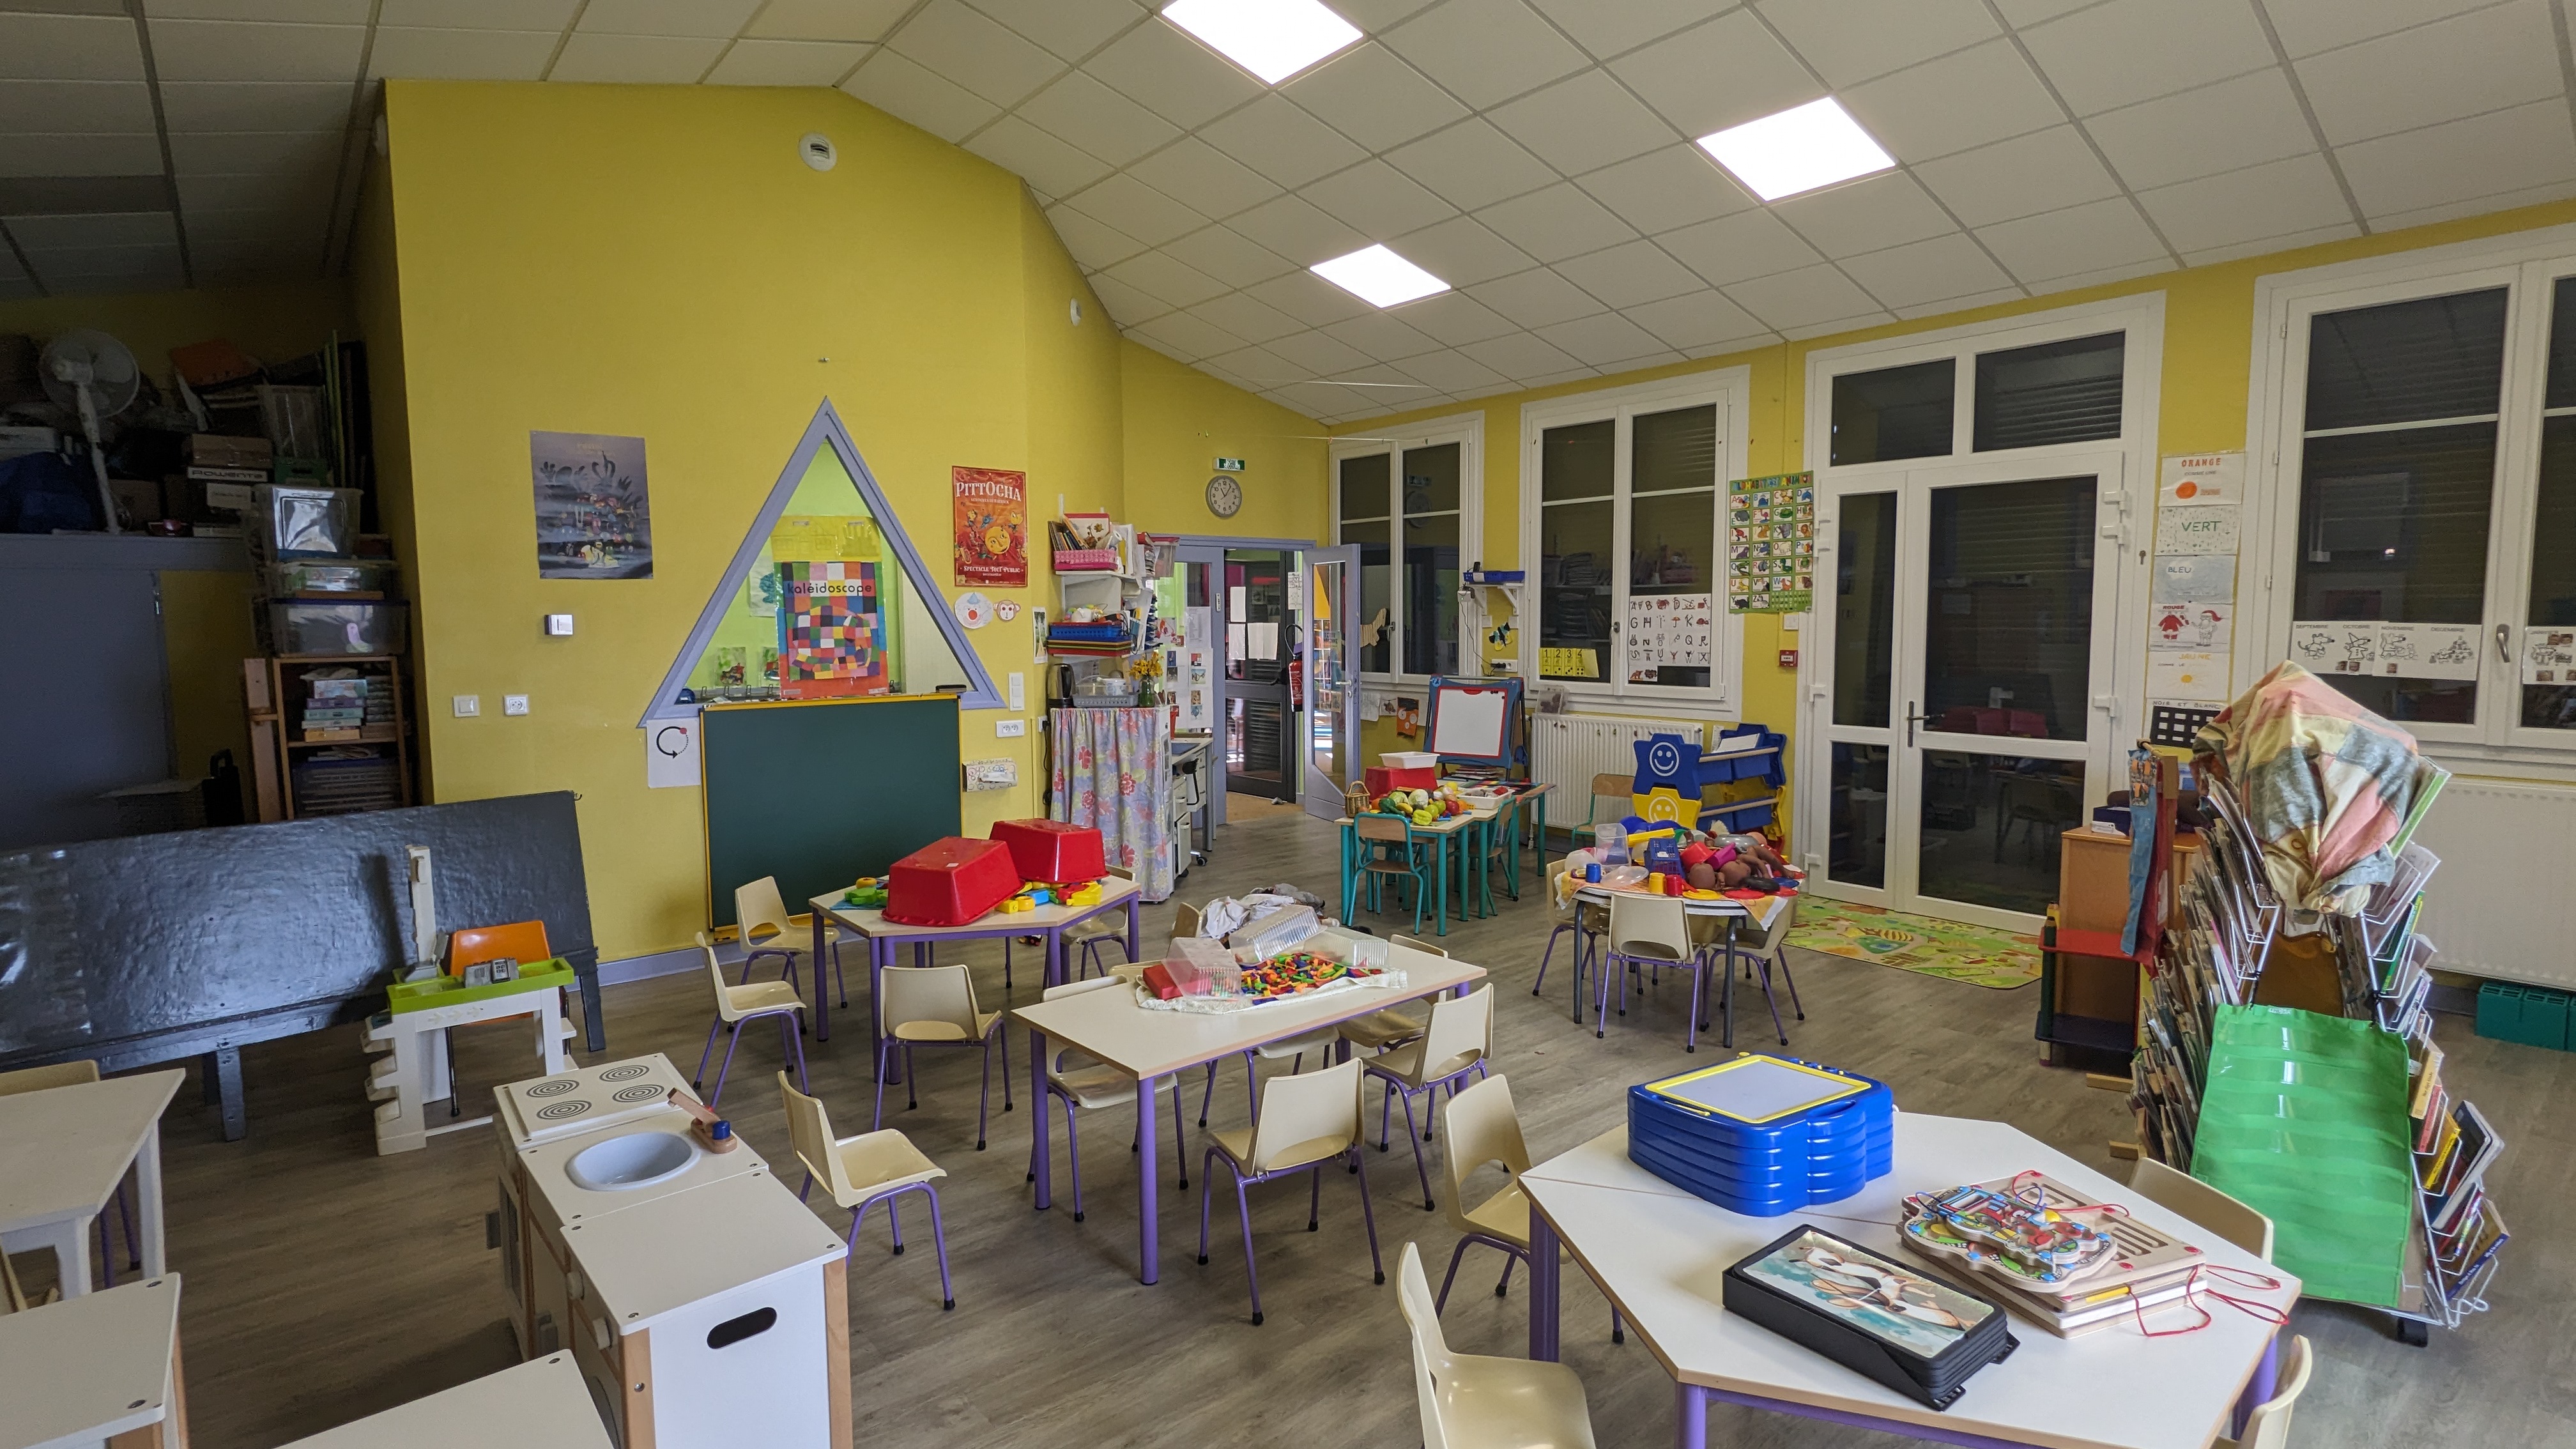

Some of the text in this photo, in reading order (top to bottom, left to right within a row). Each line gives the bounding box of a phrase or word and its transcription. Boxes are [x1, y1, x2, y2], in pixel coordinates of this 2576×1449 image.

[2181, 457, 2221, 467] ORANGE
[2181, 521, 2222, 532] VERT
[788, 582, 871, 596] kaléidoscope
[1645, 601, 1652, 611] B
[1630, 617, 1638, 629] G
[1643, 617, 1652, 628] H
[1685, 614, 1693, 627] K
[1685, 634, 1694, 646] Q
[1699, 636, 1708, 647] R
[1544, 649, 1583, 658] 1 2 3 4
